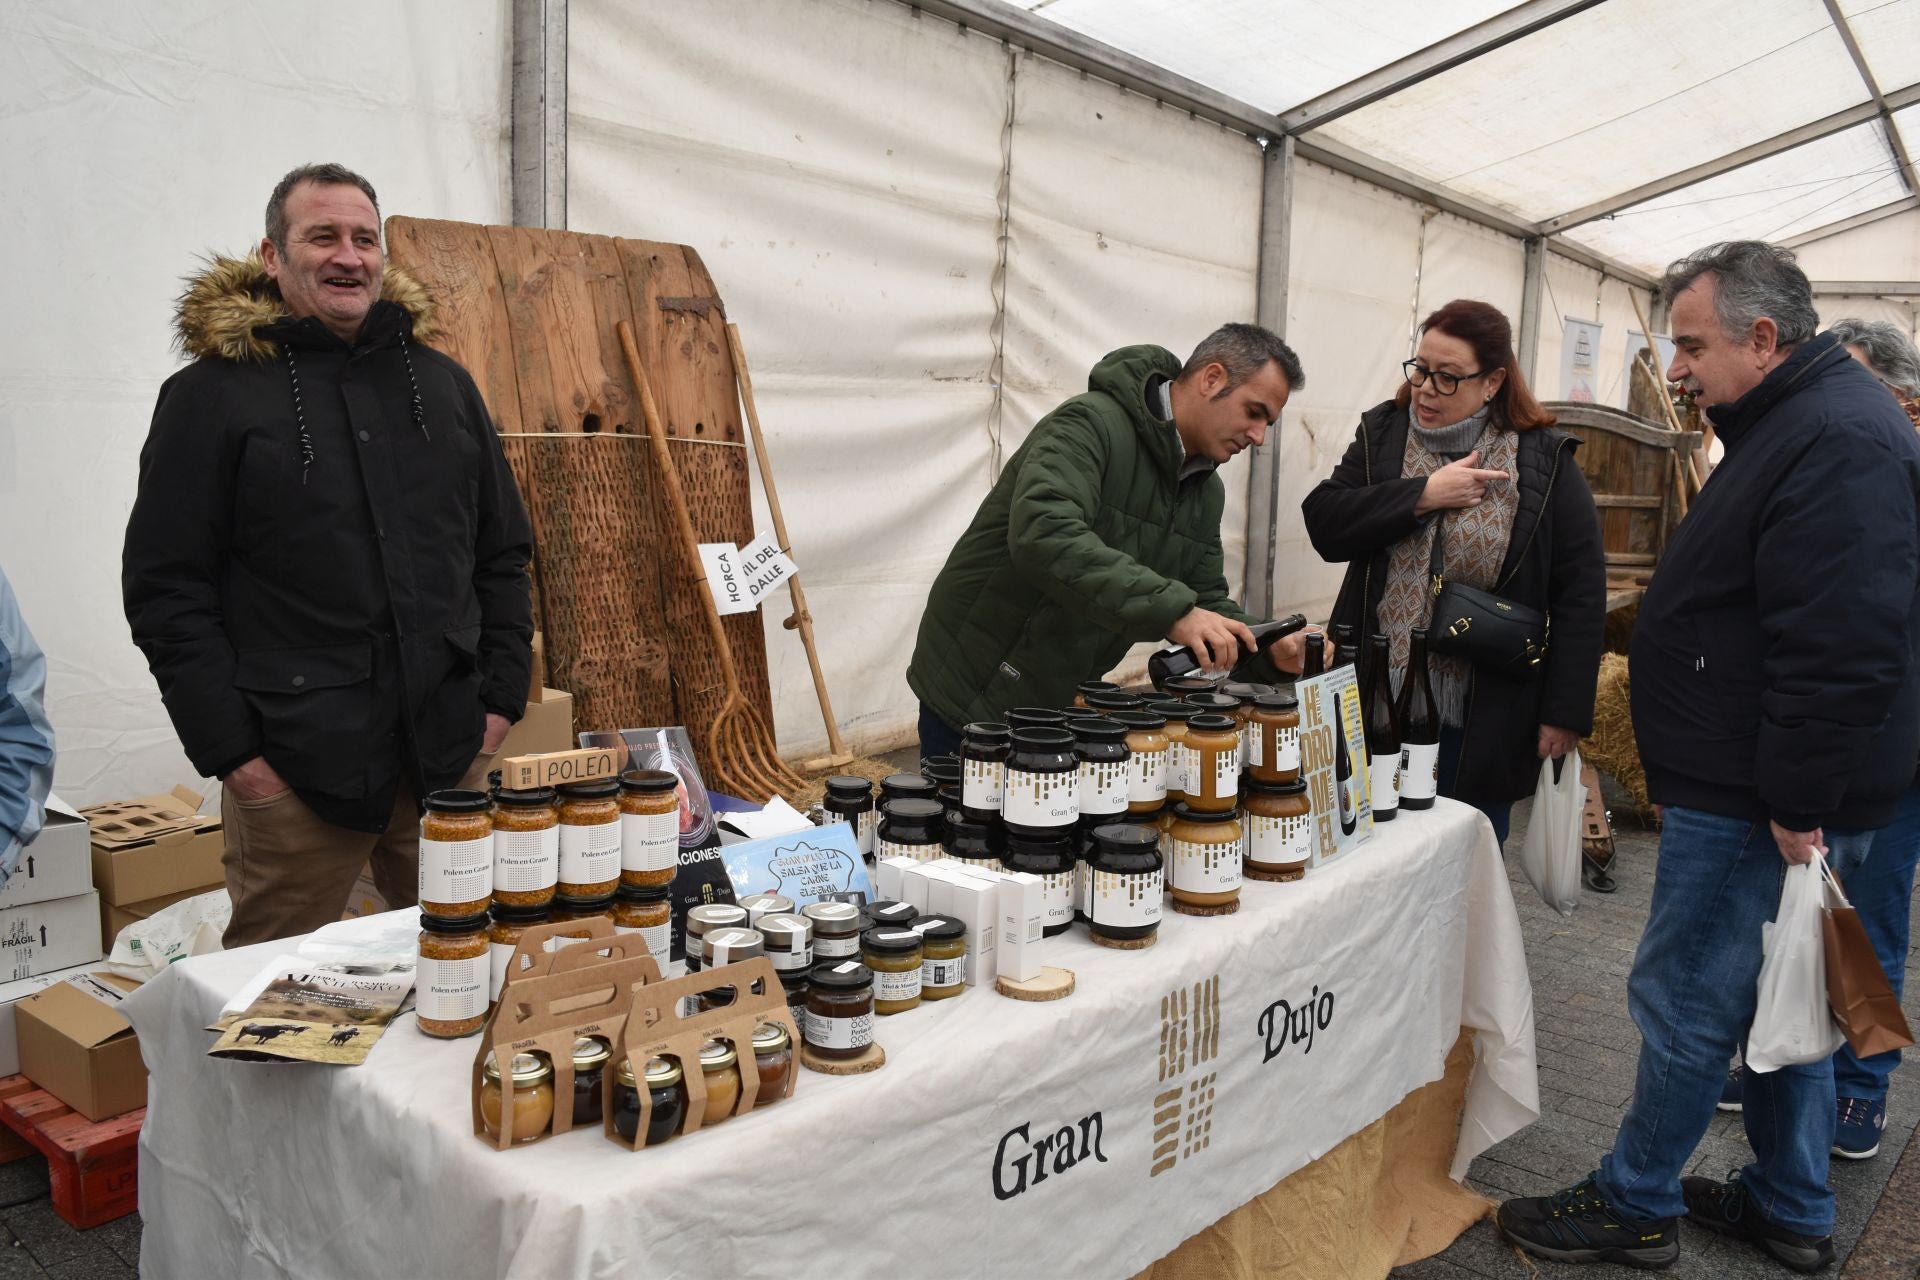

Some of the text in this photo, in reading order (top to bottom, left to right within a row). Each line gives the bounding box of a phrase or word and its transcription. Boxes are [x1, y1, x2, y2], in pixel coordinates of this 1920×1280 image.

[755, 545, 779, 564] DEL
[718, 552, 741, 603] HORCA
[749, 564, 784, 596] DALLE
[547, 754, 612, 782] POLEN
[1051, 808, 1068, 817] Gran
[500, 857, 518, 865] Polen
[825, 850, 839, 860] LA
[443, 868, 463, 876] Polen
[780, 860, 842, 878] SALSA QUE LA
[800, 873, 830, 886] CARNE
[684, 886, 731, 904] Gran Dujo
[1048, 908, 1065, 917] Gran
[431, 985, 450, 993] Polen
[460, 984, 480, 993] Grano
[991, 984, 1335, 1201] Gran Dujo
